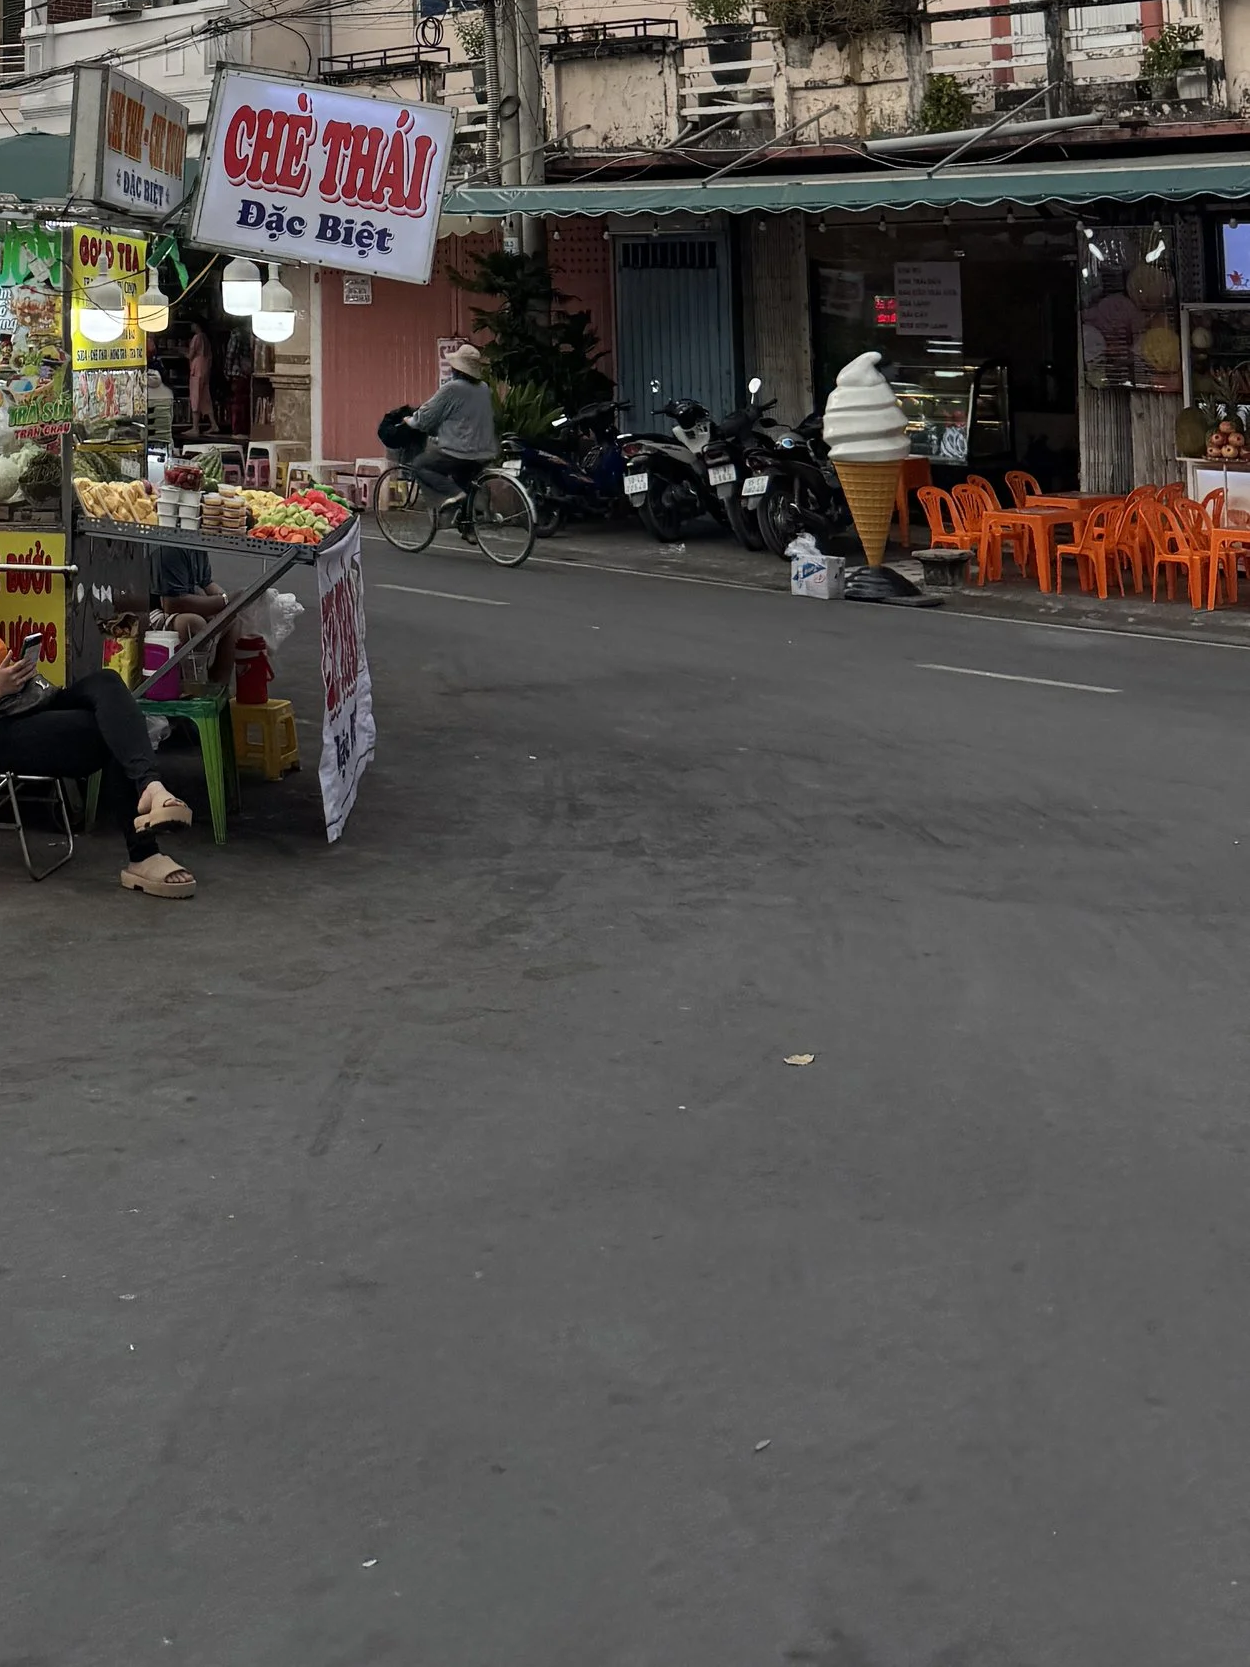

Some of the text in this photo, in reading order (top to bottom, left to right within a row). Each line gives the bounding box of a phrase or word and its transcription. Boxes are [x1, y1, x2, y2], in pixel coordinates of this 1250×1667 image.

[224, 92, 437, 218] CHÈ THÁI
[123, 169, 164, 210] ĐẶC BIỆT
[236, 199, 395, 258] Đặc Biệt
[117, 242, 140, 272] TEA
[6, 540, 52, 594] BƯỞI
